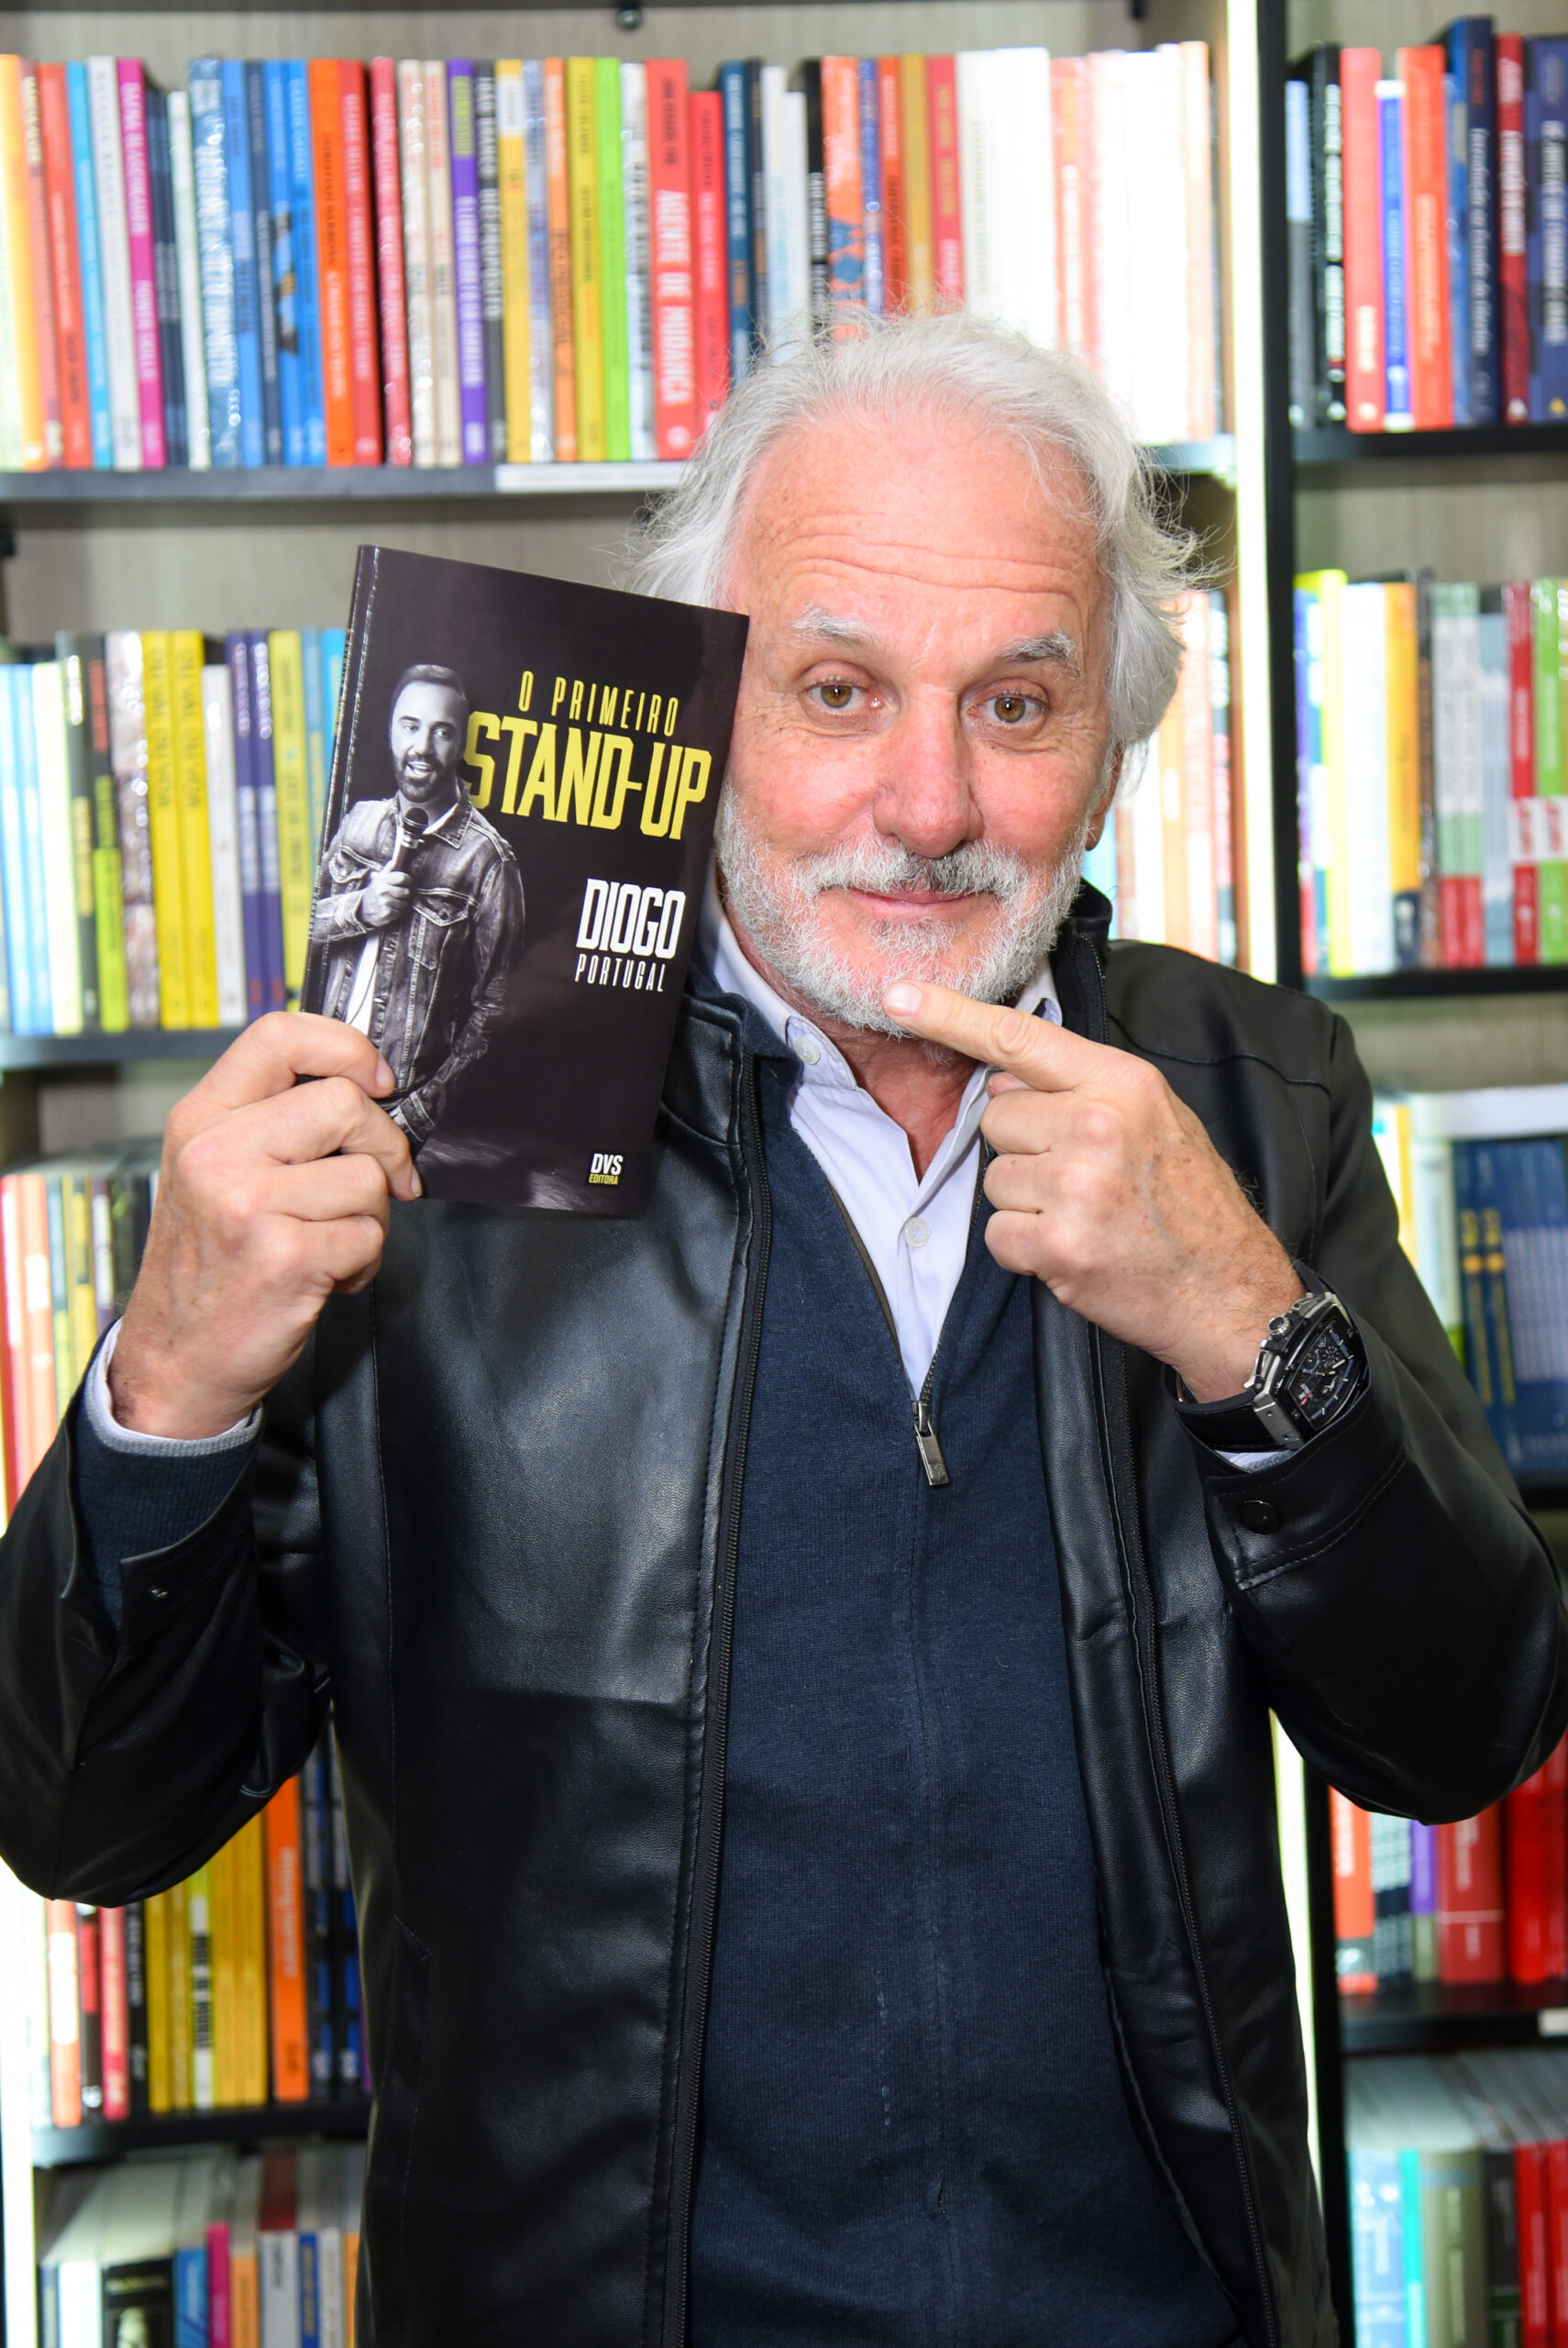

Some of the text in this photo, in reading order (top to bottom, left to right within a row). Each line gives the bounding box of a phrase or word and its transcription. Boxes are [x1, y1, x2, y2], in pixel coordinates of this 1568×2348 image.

[517, 670, 679, 737] O PRIMEIRO
[462, 710, 712, 840] STAND-UP
[575, 878, 687, 959] DIOGO
[574, 953, 666, 992] PORTUGAL
[588, 1173, 619, 1185] EDITORA
[590, 1152, 624, 1176] DVS
